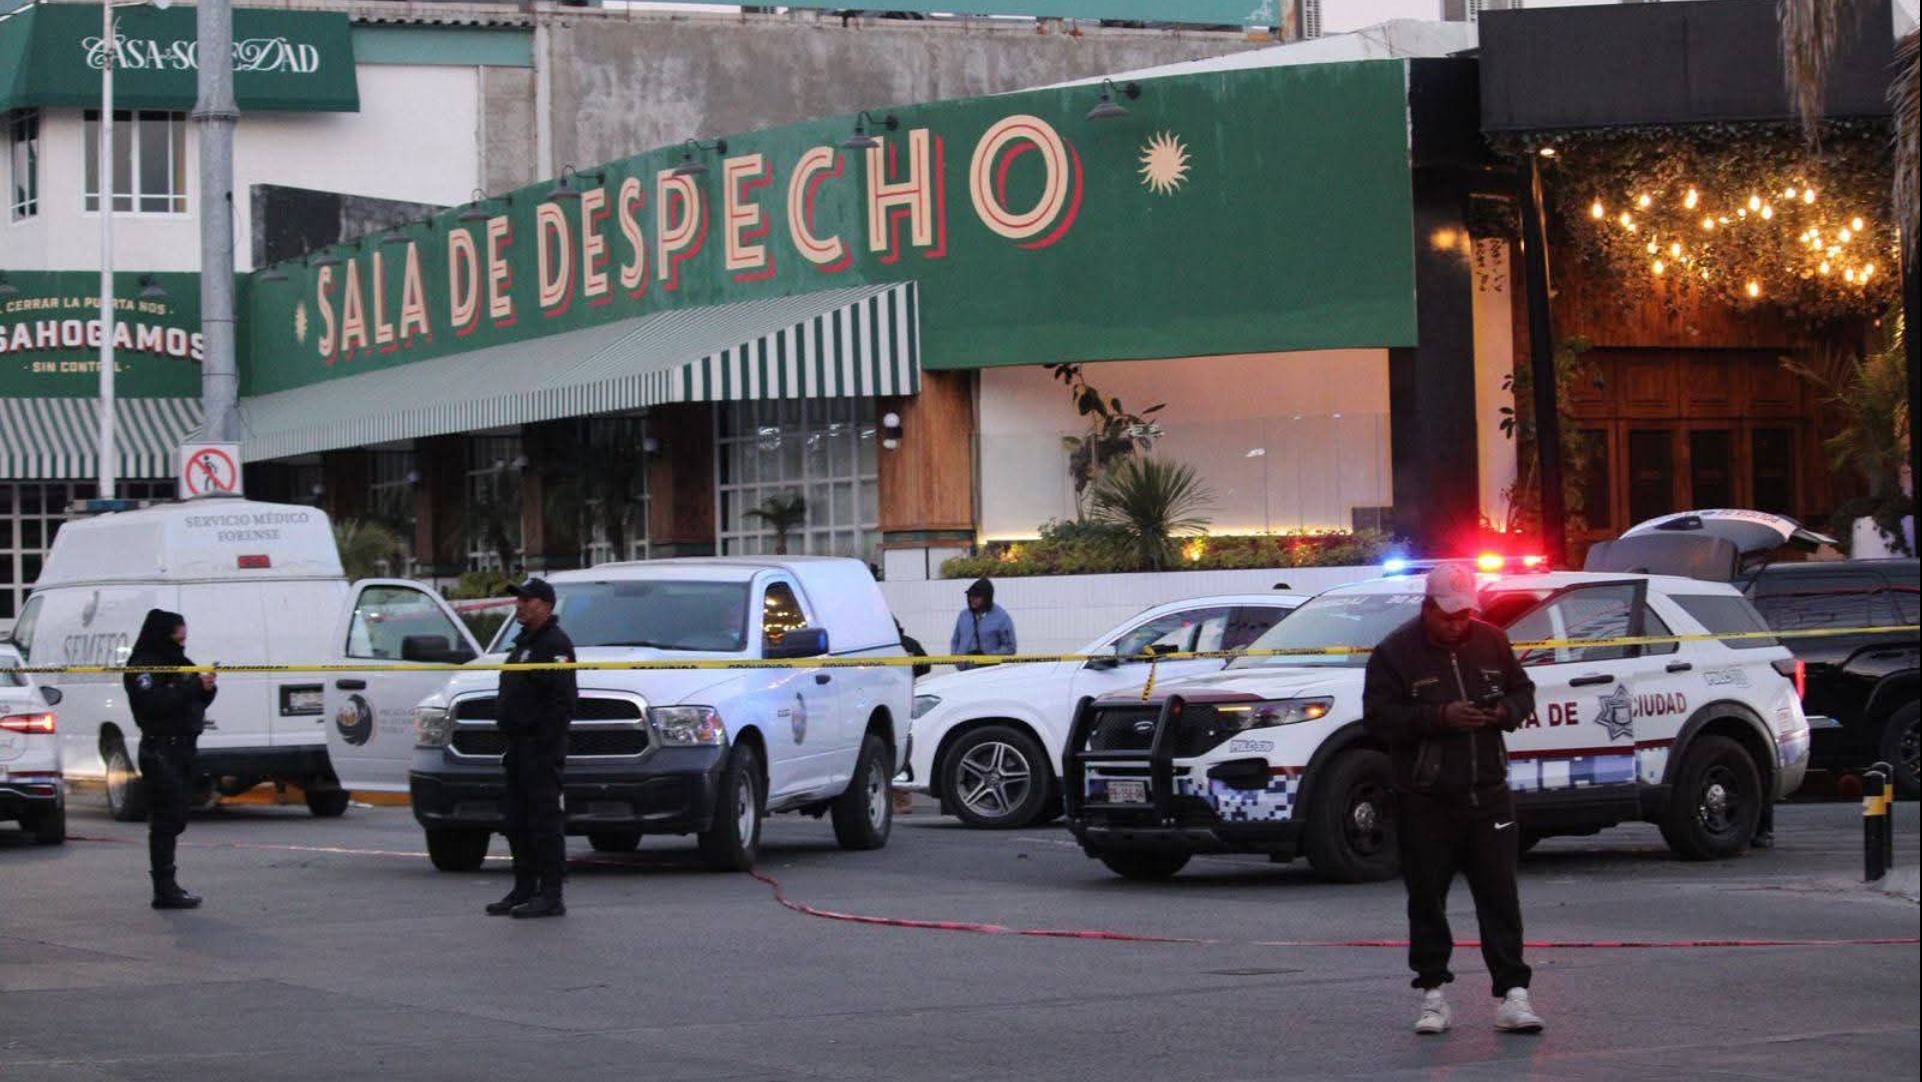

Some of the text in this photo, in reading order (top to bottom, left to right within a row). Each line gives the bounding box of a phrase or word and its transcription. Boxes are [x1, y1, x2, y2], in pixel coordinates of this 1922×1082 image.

[172, 37, 319, 72] SOEDAD
[317, 114, 1082, 362] SALA DE DESPECHO
[6, 298, 58, 312] CERRAR
[64, 296, 81, 308] LA
[84, 297, 134, 310] PURTA
[139, 301, 166, 315] NOS
[32, 361, 122, 373] SIN CONTRL
[184, 512, 309, 528] SERVICIO MÉDICO
[218, 529, 279, 542] FORENSE
[1548, 701, 1579, 727] DE
